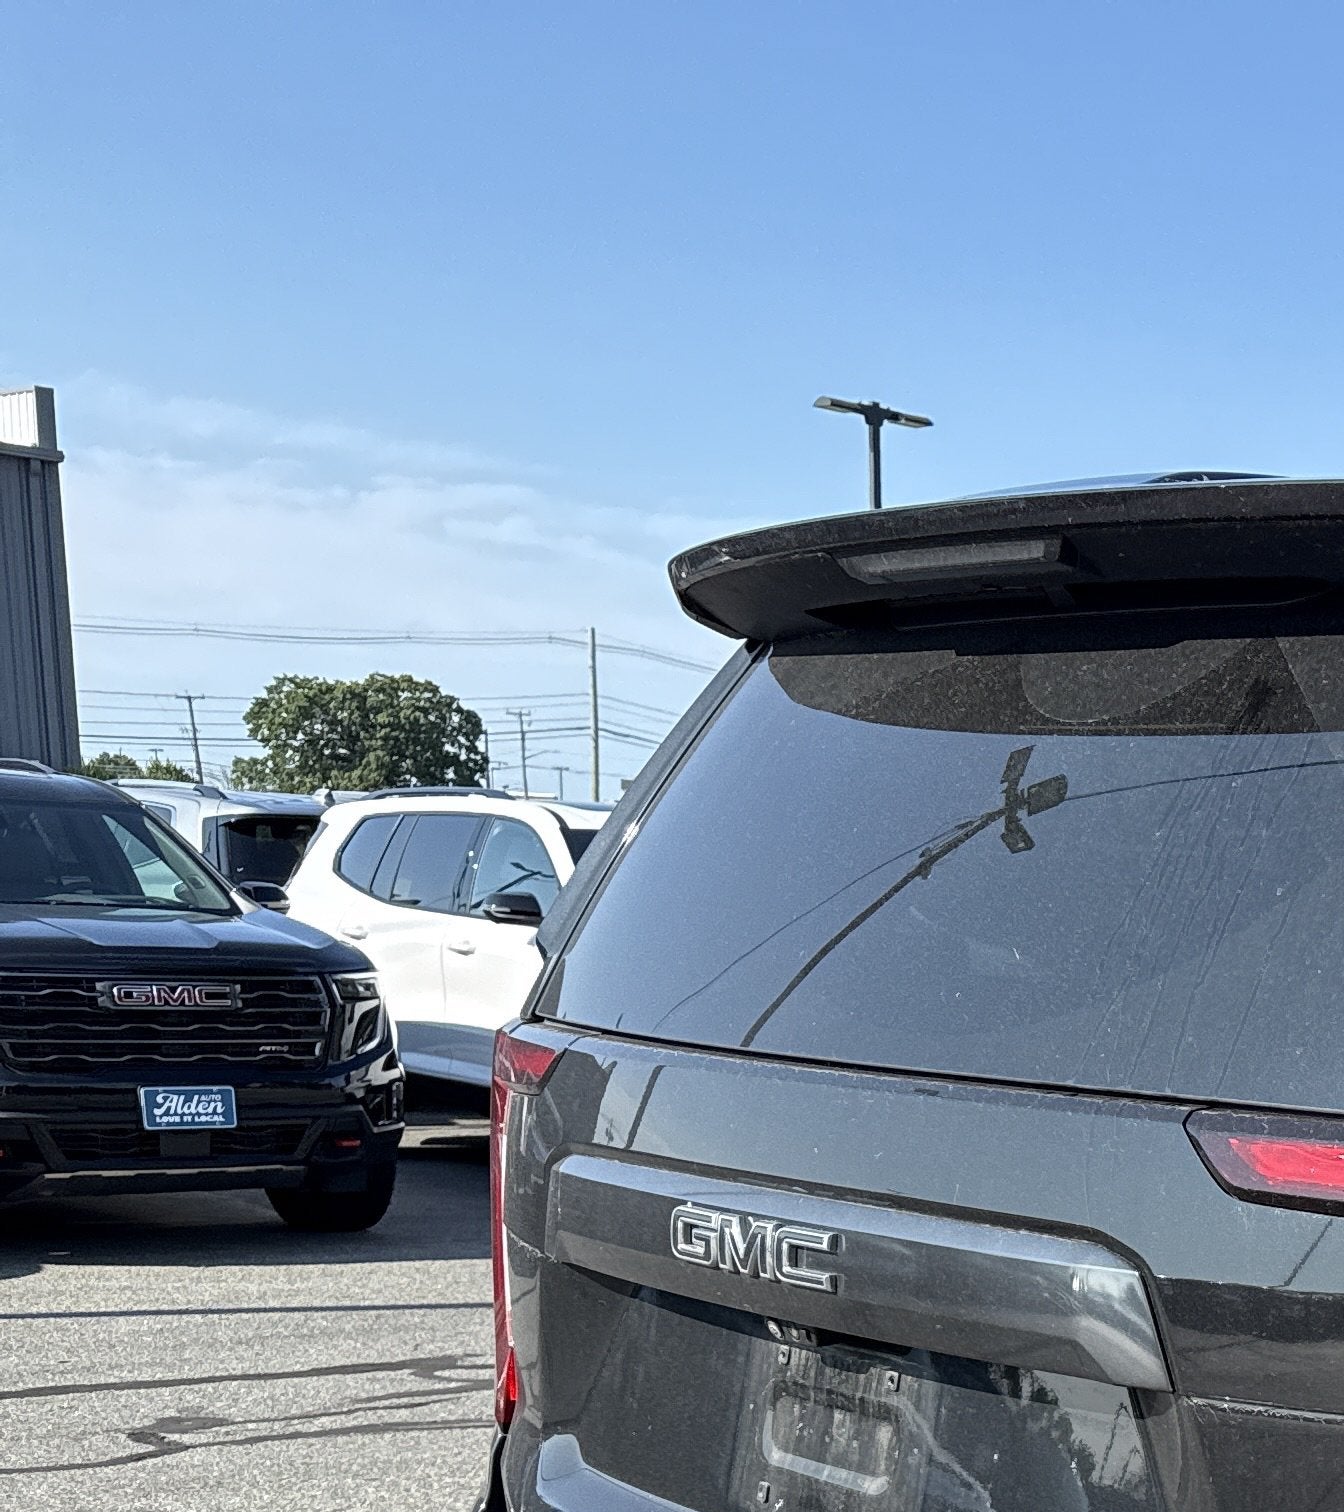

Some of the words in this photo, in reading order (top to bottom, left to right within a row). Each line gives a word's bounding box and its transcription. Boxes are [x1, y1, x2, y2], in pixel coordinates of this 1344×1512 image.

[112, 984, 232, 1006] GMC
[153, 1092, 225, 1115] Alden
[156, 1115, 180, 1123] LOVE
[194, 1114, 226, 1122] LOCAL
[670, 1204, 843, 1294] GMC
